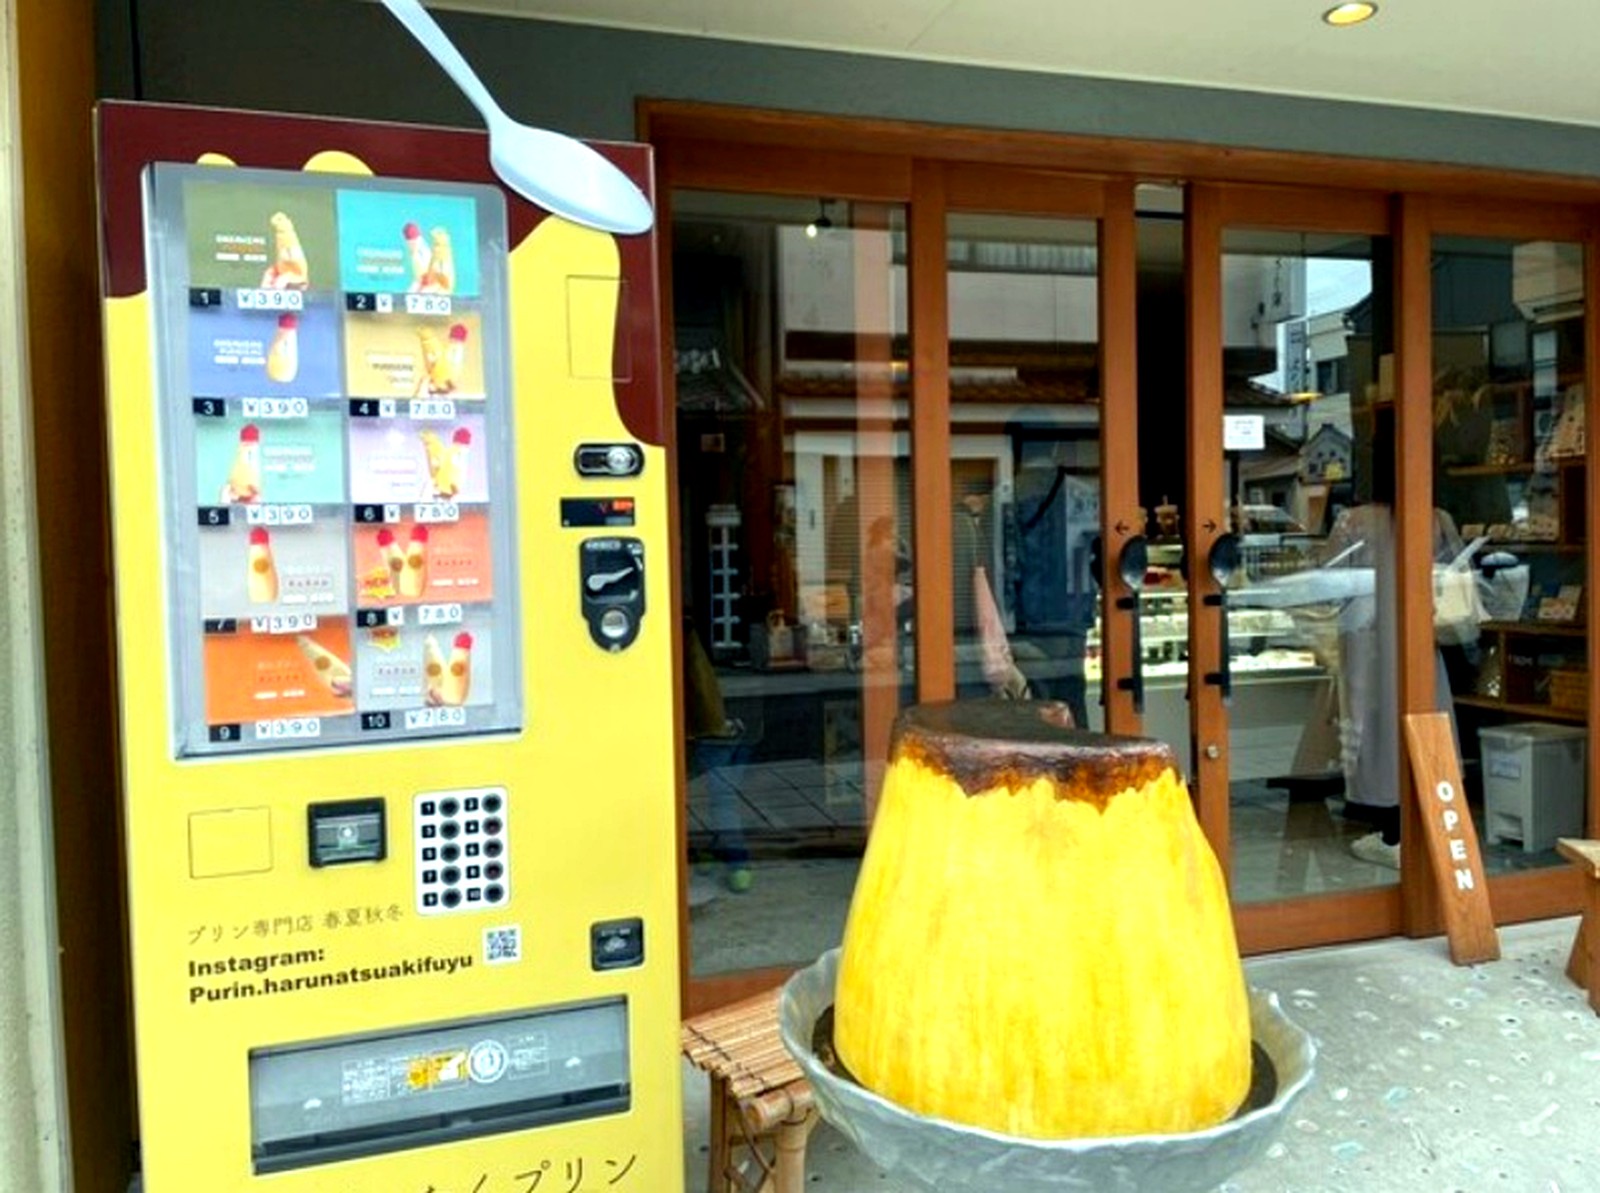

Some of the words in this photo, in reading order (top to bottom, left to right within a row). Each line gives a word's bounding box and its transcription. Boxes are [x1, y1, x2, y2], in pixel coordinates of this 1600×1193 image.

[200, 291, 210, 305] 1
[239, 291, 301, 306] ¥390
[356, 294, 367, 309] 2
[410, 297, 450, 311] 780
[204, 401, 215, 415] 3
[246, 400, 304, 415] ¥390
[359, 402, 370, 415] 4
[413, 402, 452, 416] 780
[208, 509, 219, 524] 5
[364, 506, 375, 521] 6
[418, 506, 457, 518] 780
[254, 613, 313, 630] ¥390
[366, 612, 378, 626] 8
[257, 720, 318, 735] ¥390
[367, 714, 386, 728] 10
[219, 727, 230, 739] 9
[1436, 780, 1475, 890] OPEN
[188, 915, 314, 945] プリン専門店
[322, 904, 405, 930] 春夏秋冬
[188, 948, 325, 977] Instagram:
[189, 954, 474, 1004] Purin.harunatsuakifuyu
